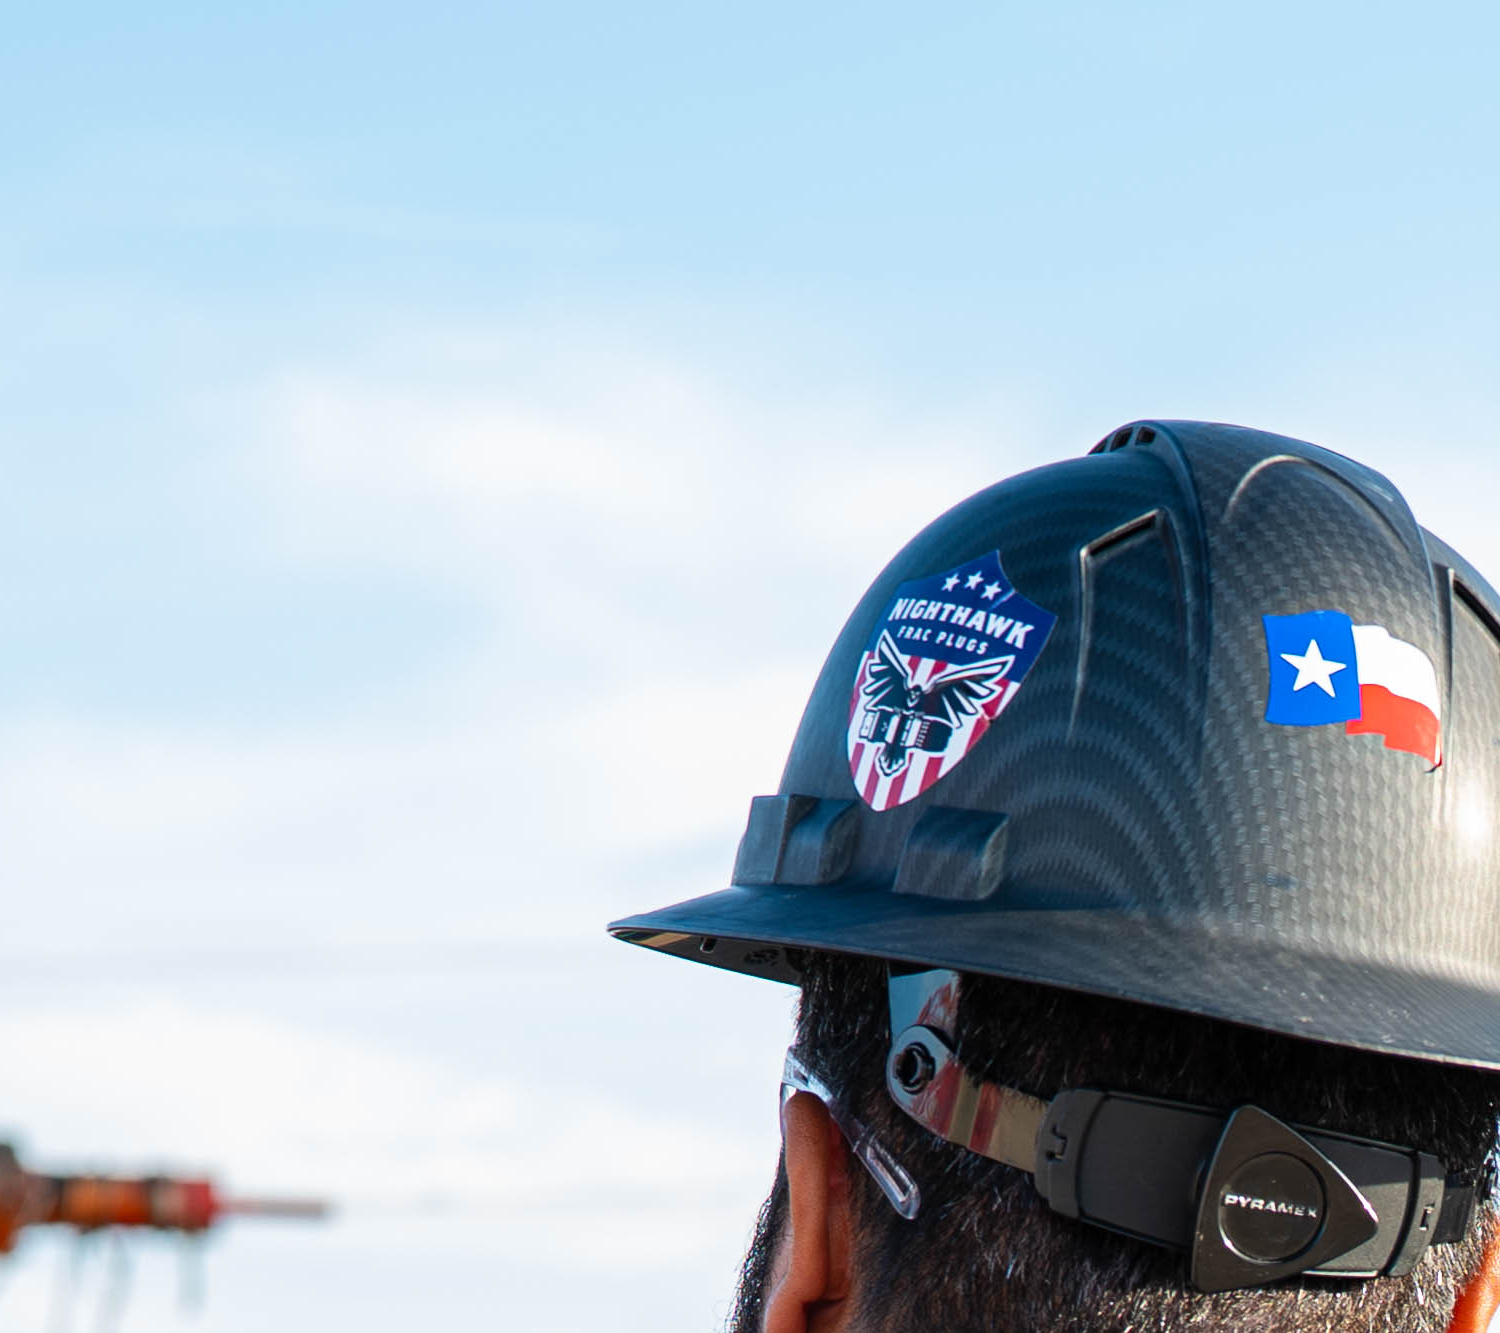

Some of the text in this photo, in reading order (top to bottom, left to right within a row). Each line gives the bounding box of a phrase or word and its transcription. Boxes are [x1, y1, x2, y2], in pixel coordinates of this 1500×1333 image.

[888, 598, 1035, 649] NIGHTHAWK
[897, 625, 989, 655] FRAC PLUGS
[1224, 1194, 1319, 1219] PYRAMEX
